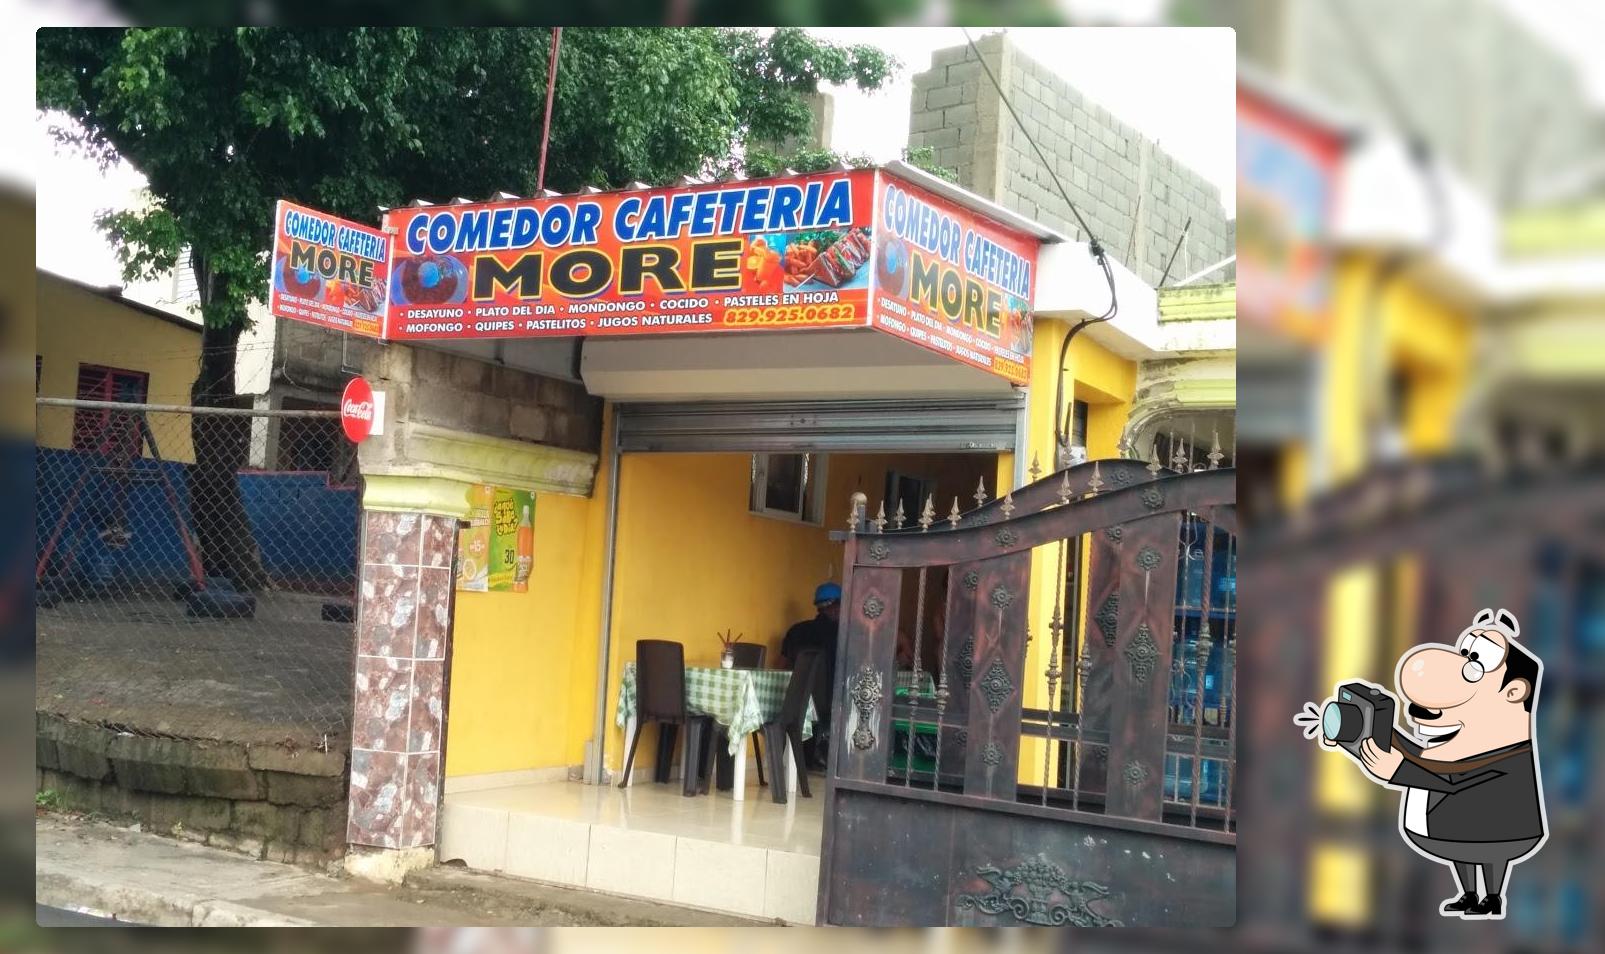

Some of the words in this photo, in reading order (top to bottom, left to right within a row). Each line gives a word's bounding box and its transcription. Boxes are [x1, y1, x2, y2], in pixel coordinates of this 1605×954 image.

[284, 209, 337, 248] COMEDOR
[337, 226, 386, 263] CAFETERIA
[406, 202, 602, 255] COMEDOR
[614, 179, 852, 242] CAFETERIA
[884, 184, 961, 265] COMEDOR
[964, 229, 1030, 300] CAFETERIA
[290, 240, 375, 288] MORE
[472, 237, 744, 302] MORE
[407, 308, 464, 319] DESAYUNO
[475, 307, 510, 317] PLATO
[512, 306, 532, 316] DEL
[537, 305, 555, 315] DIA
[568, 301, 645, 314] MONDONGO
[659, 298, 709, 310] COCIDO
[724, 295, 781, 306] PASTELES
[783, 294, 801, 305] EN
[803, 291, 839, 304] HOJA
[723, 306, 854, 325] 829.925.0682
[910, 251, 1001, 338] MORE
[406, 322, 463, 333] MOFONGO
[475, 320, 515, 332] QUIPES
[526, 319, 586, 330] PASTELITOS
[597, 316, 638, 328] JUGOS
[642, 313, 713, 326] NATURALES
[504, 549, 515, 565] 30
